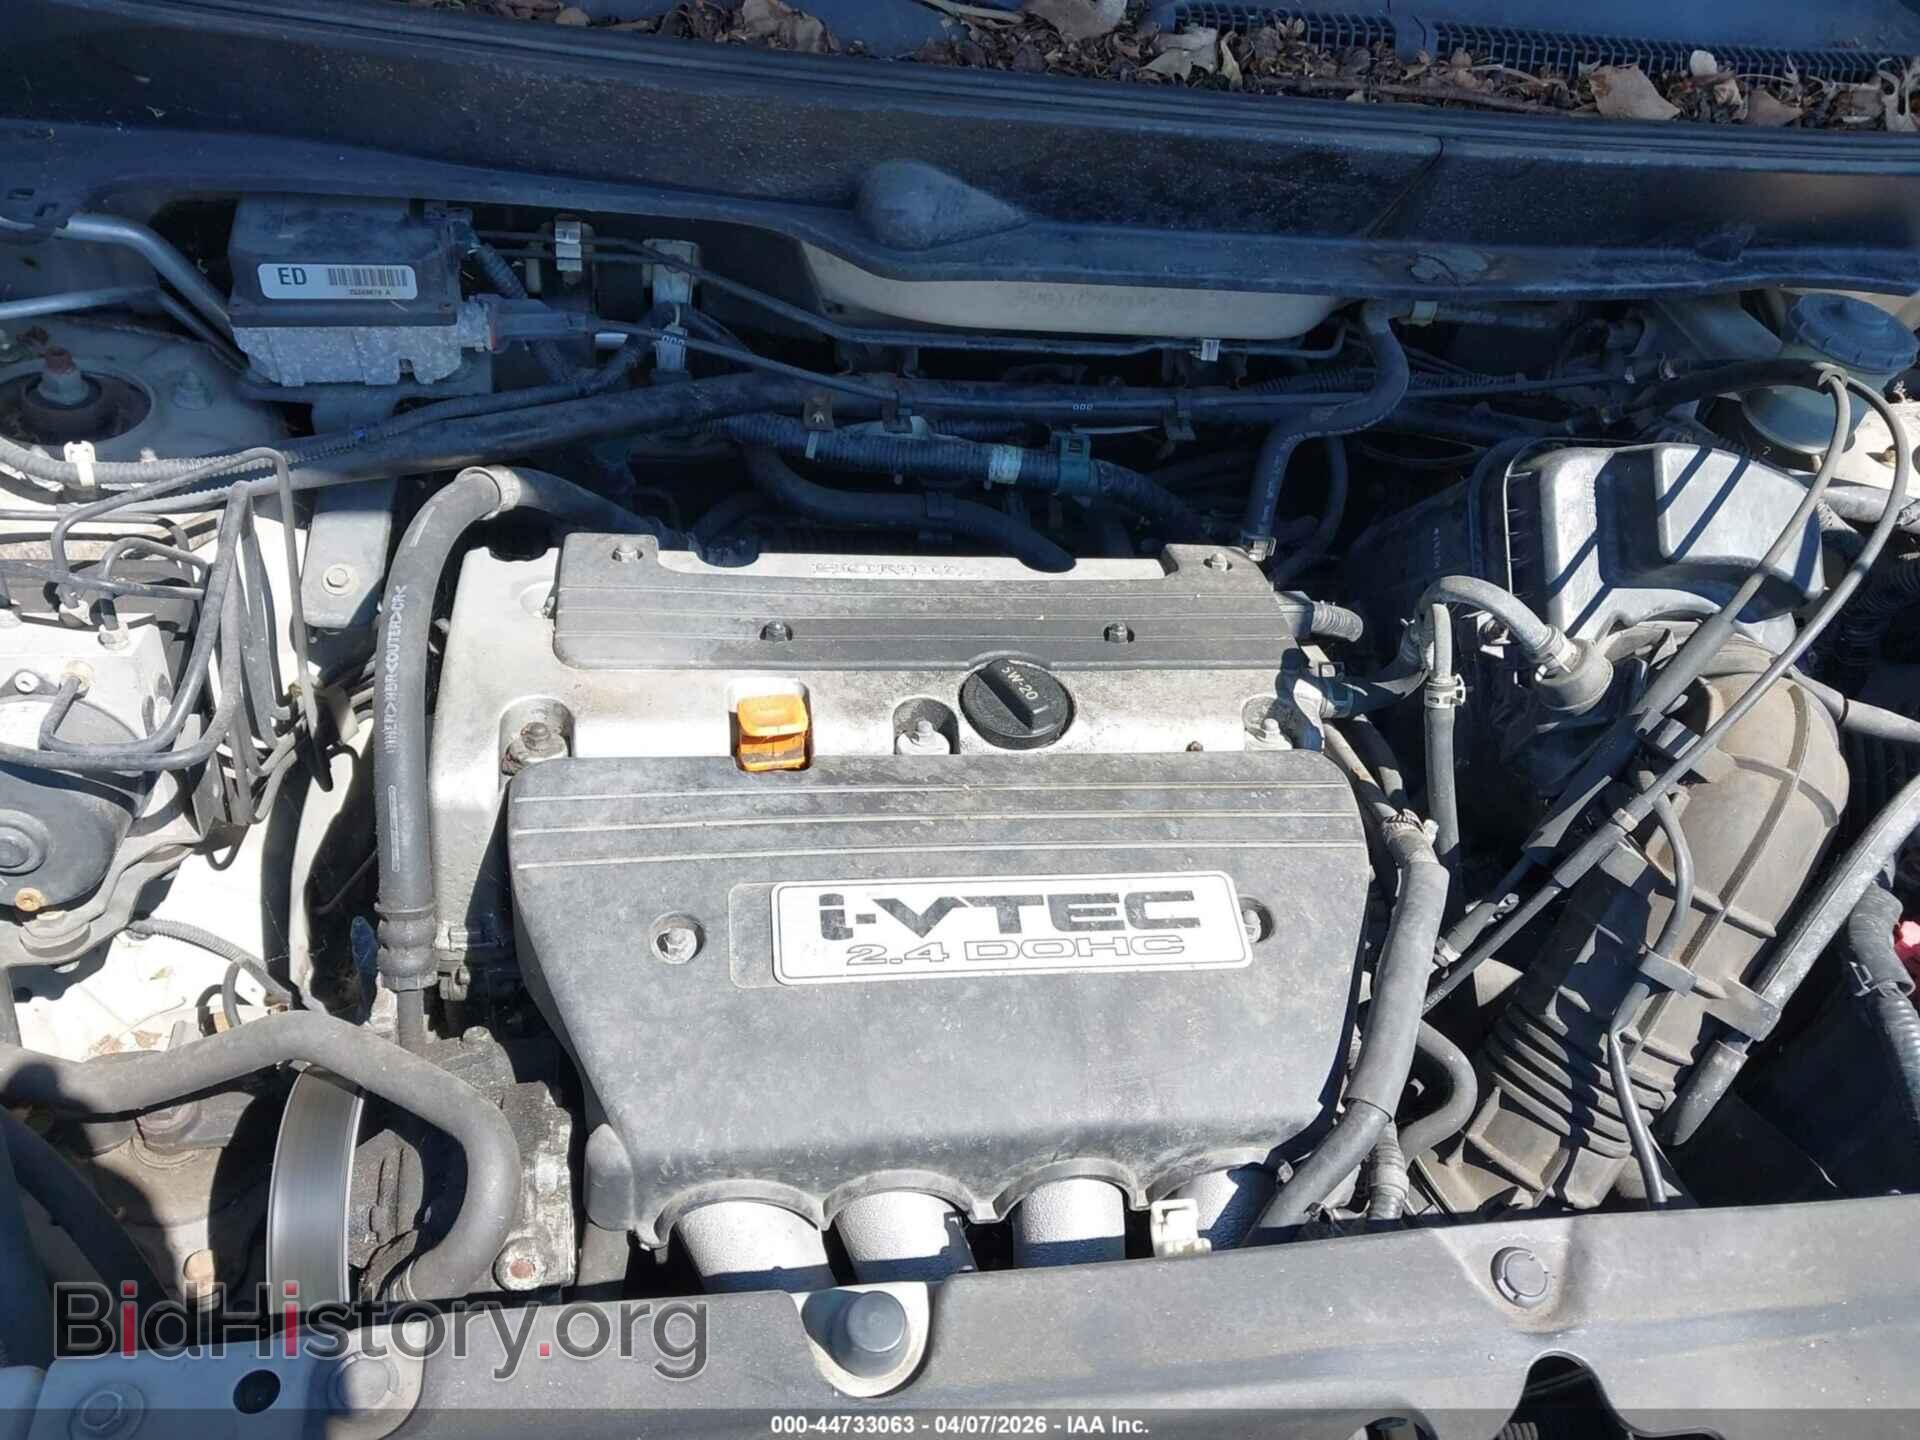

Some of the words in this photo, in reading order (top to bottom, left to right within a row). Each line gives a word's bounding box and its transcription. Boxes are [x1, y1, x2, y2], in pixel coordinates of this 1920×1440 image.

[277, 267, 307, 285] ED
[1001, 666, 1038, 700] 5W-20
[818, 890, 1201, 941] i-VTEC
[846, 941, 950, 966] 2.4
[964, 935, 1185, 961] DOHC
